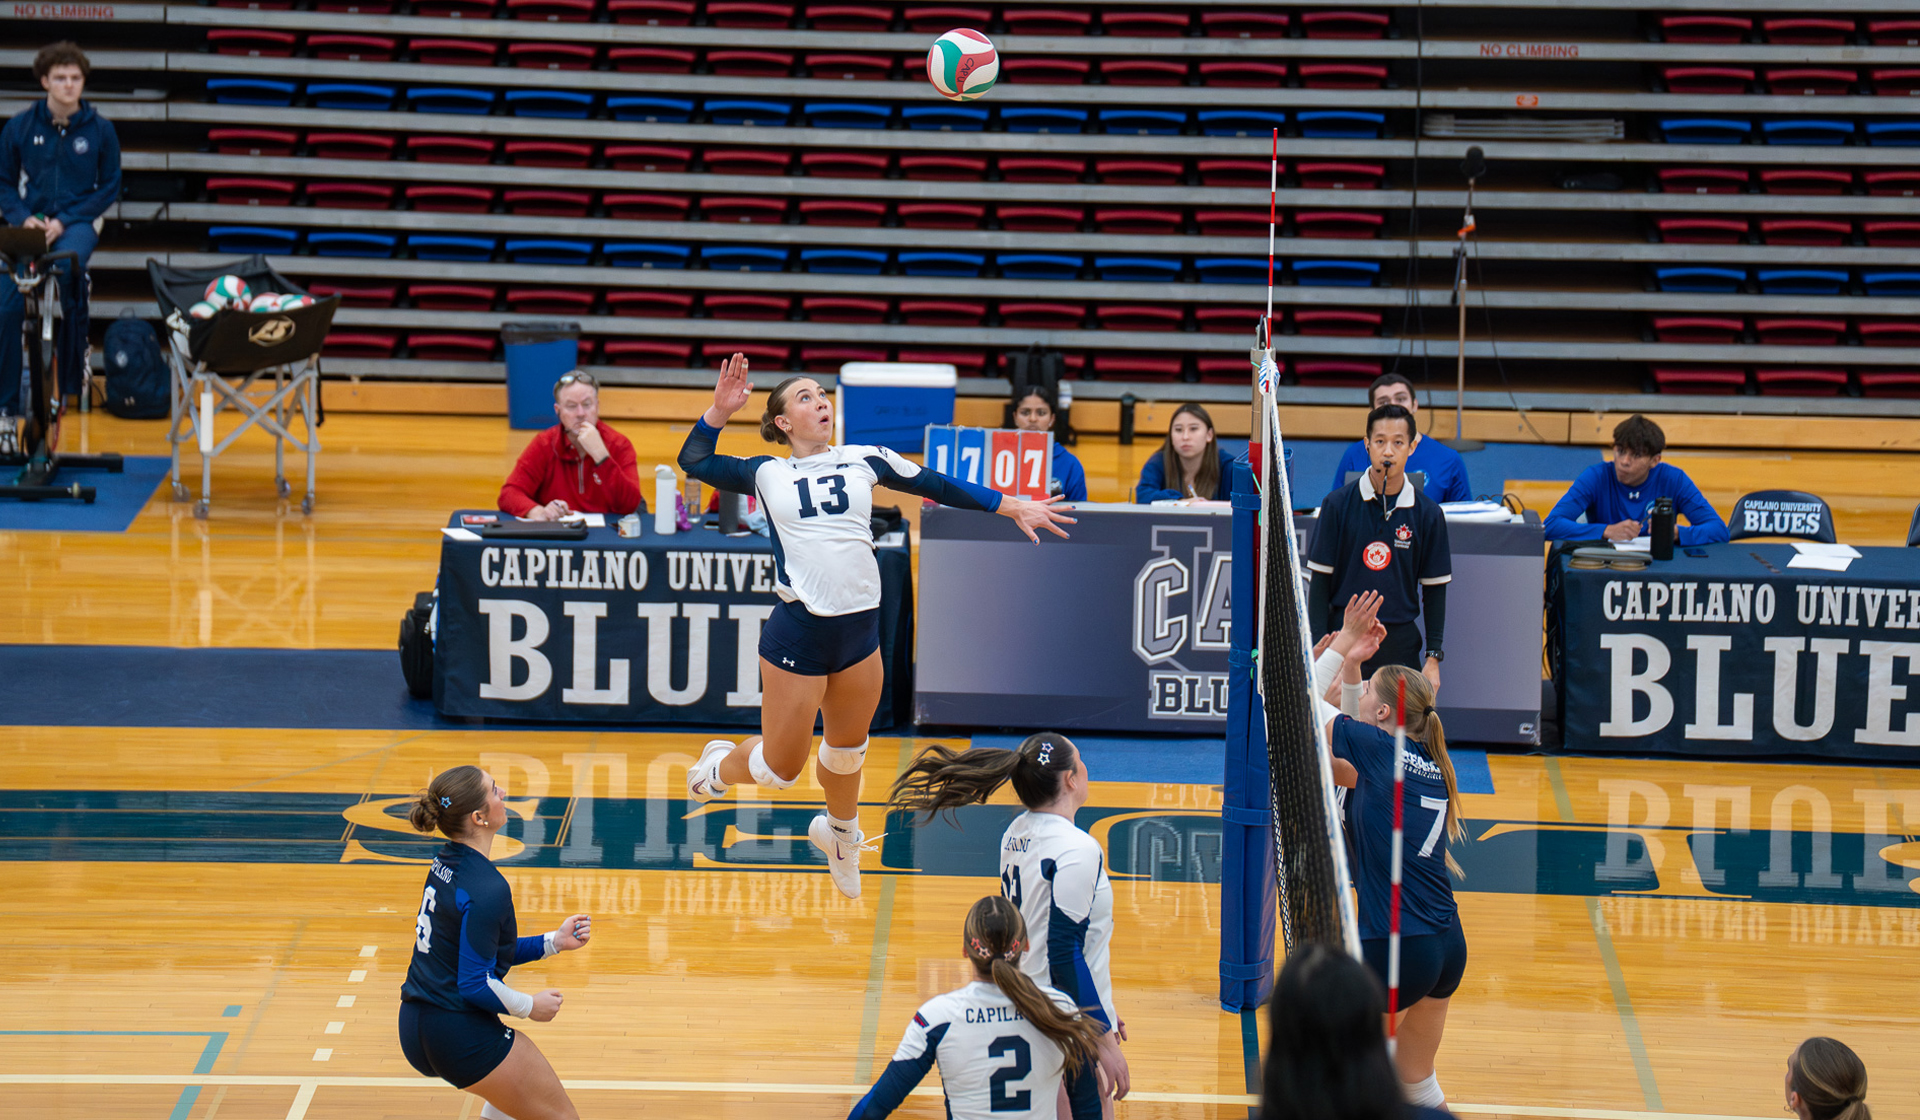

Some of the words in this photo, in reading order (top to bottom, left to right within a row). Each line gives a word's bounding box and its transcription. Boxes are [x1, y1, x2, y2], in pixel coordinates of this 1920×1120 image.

[14, 4, 36, 17] NO
[41, 4, 114, 18] CLIMBING
[957, 57, 975, 83] CAPU
[1480, 44, 1502, 57] NO
[1506, 44, 1579, 58] CLIMBING
[793, 474, 850, 519] 13
[1744, 500, 1779, 511] CAPILANO
[1780, 501, 1822, 513] UNIVERSITY
[1744, 510, 1821, 535] BLUES
[480, 546, 649, 591] CAPILANO
[666, 551, 778, 593] UNIVE
[1603, 580, 1776, 625] CAPILANO
[1417, 795, 1449, 857] 7
[416, 885, 437, 954] 6
[988, 1035, 1032, 1112] 2
